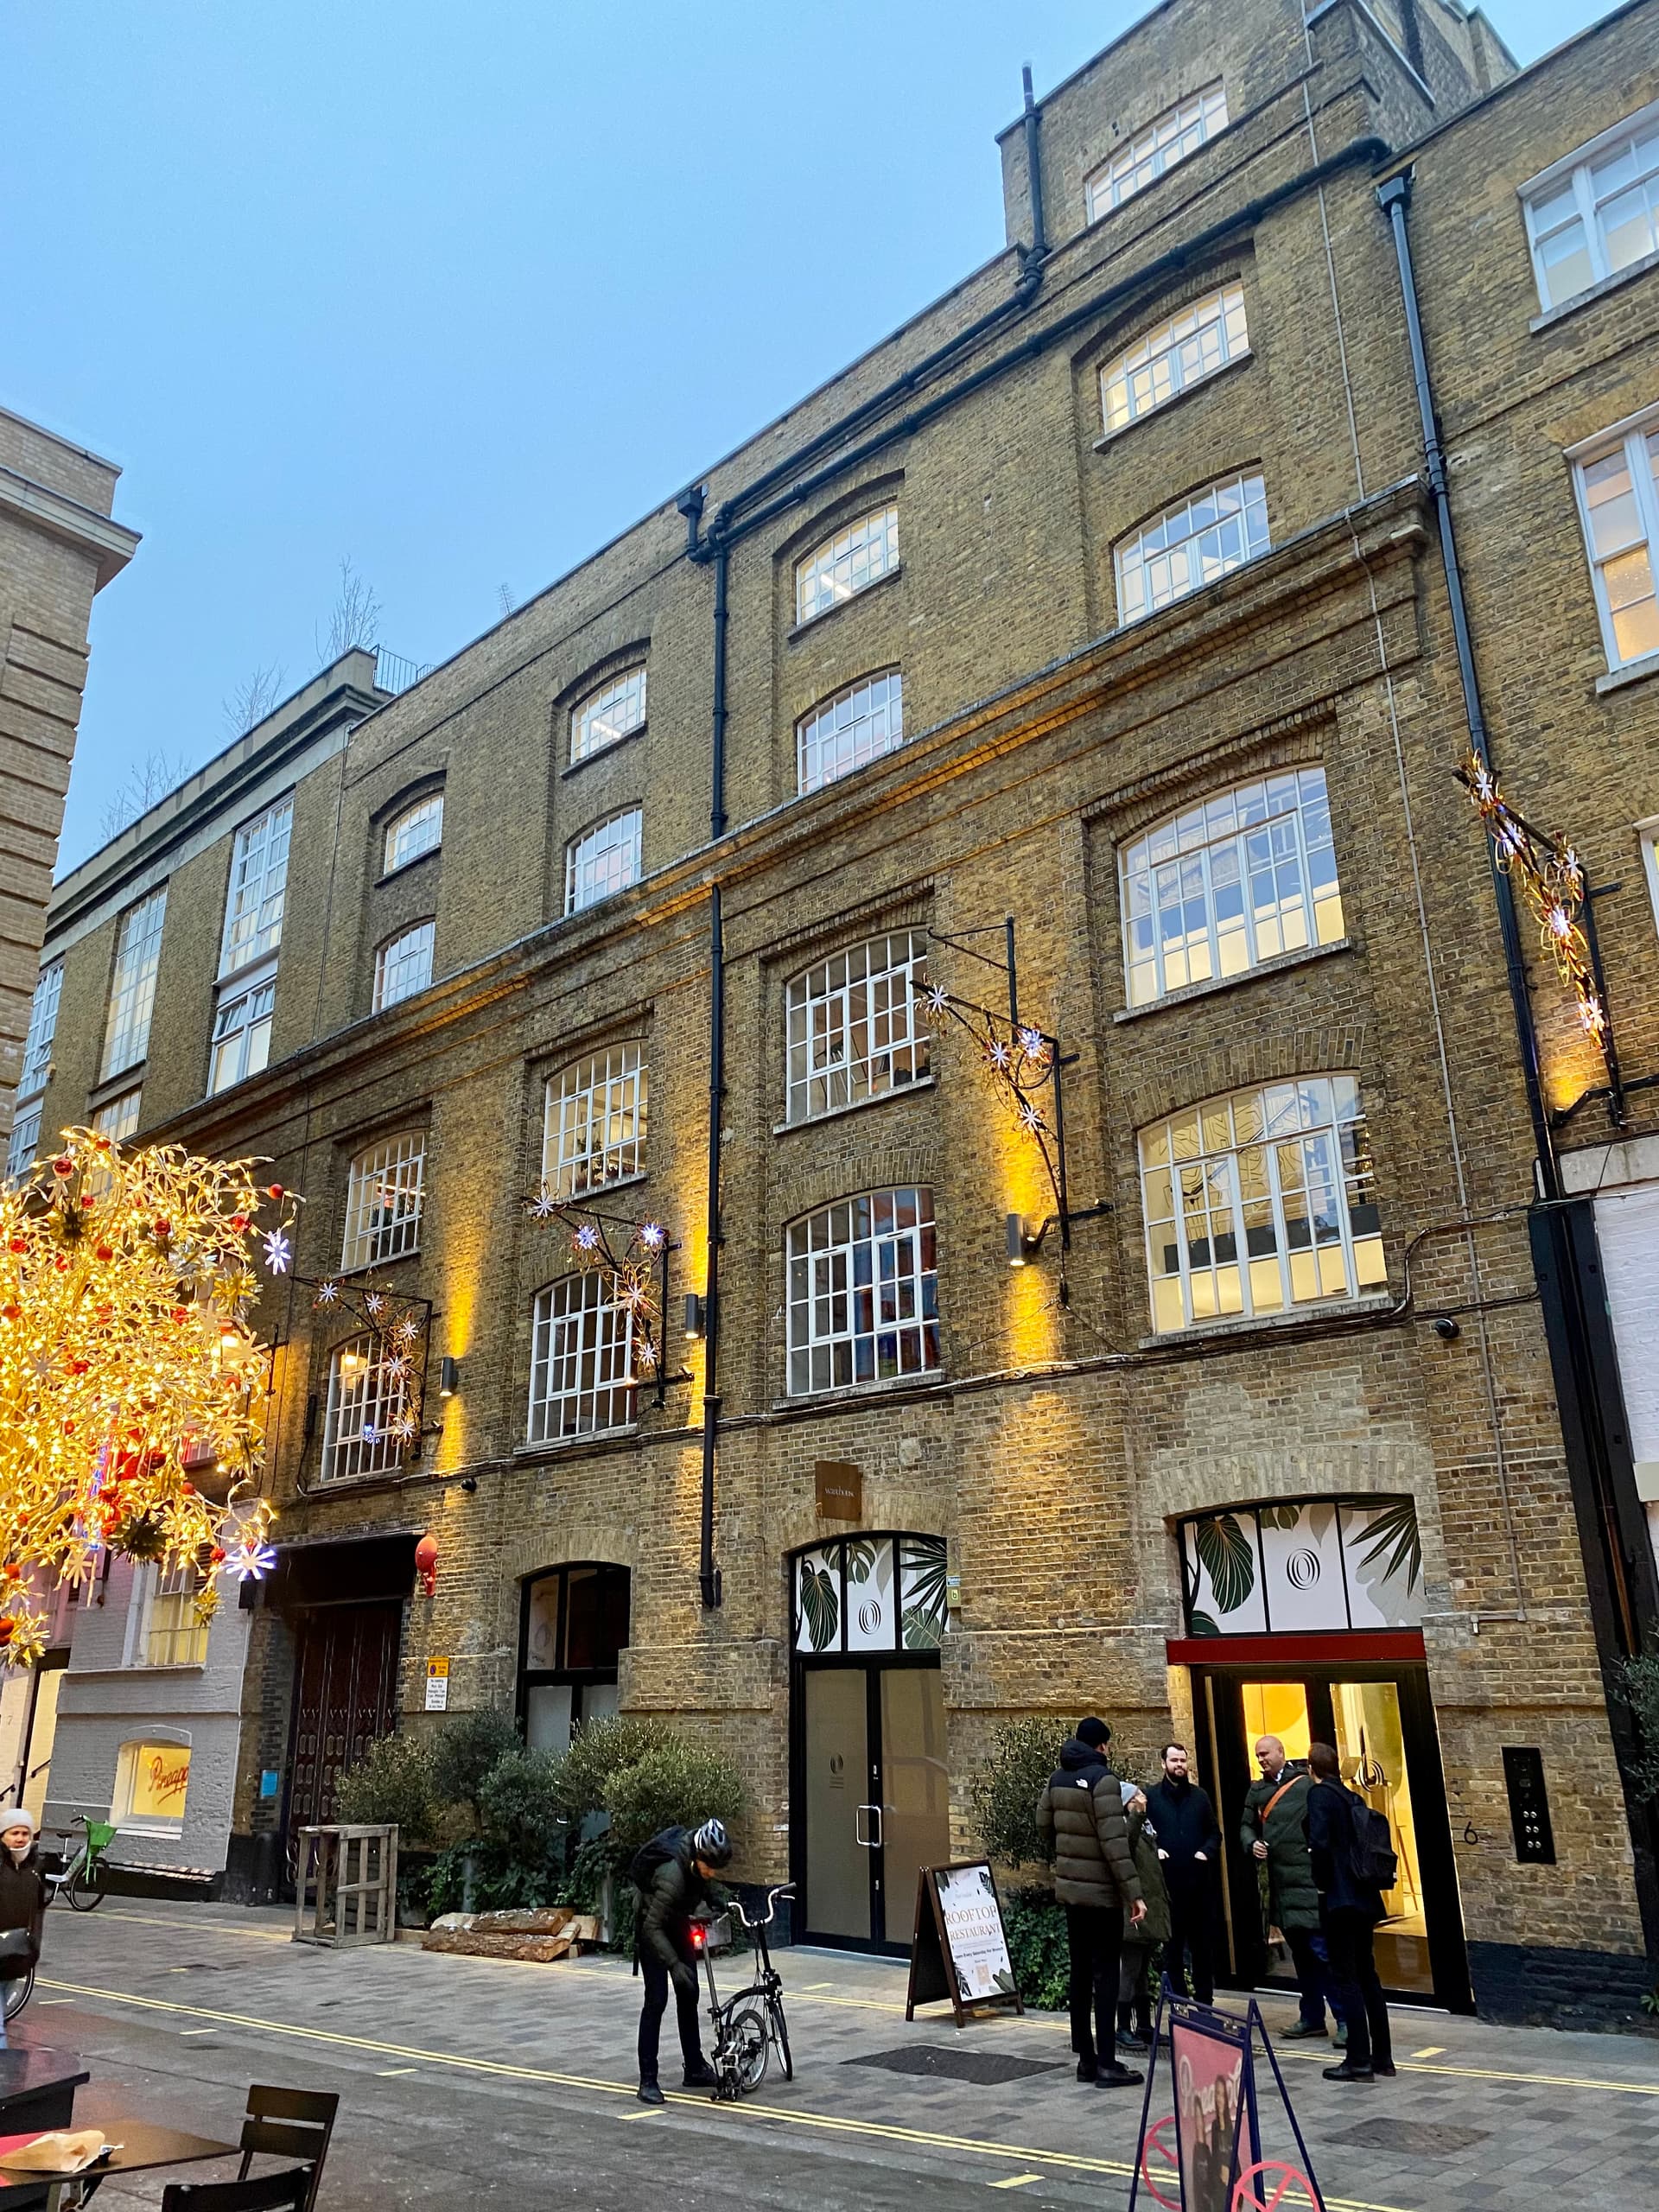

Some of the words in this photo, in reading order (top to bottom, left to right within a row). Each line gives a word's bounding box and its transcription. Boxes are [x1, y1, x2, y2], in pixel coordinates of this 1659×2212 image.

[1465, 1821, 1478, 1846] 6
[944, 1904, 997, 1925] ROOFTOP
[949, 1922, 1001, 1942] RESTAURANT
